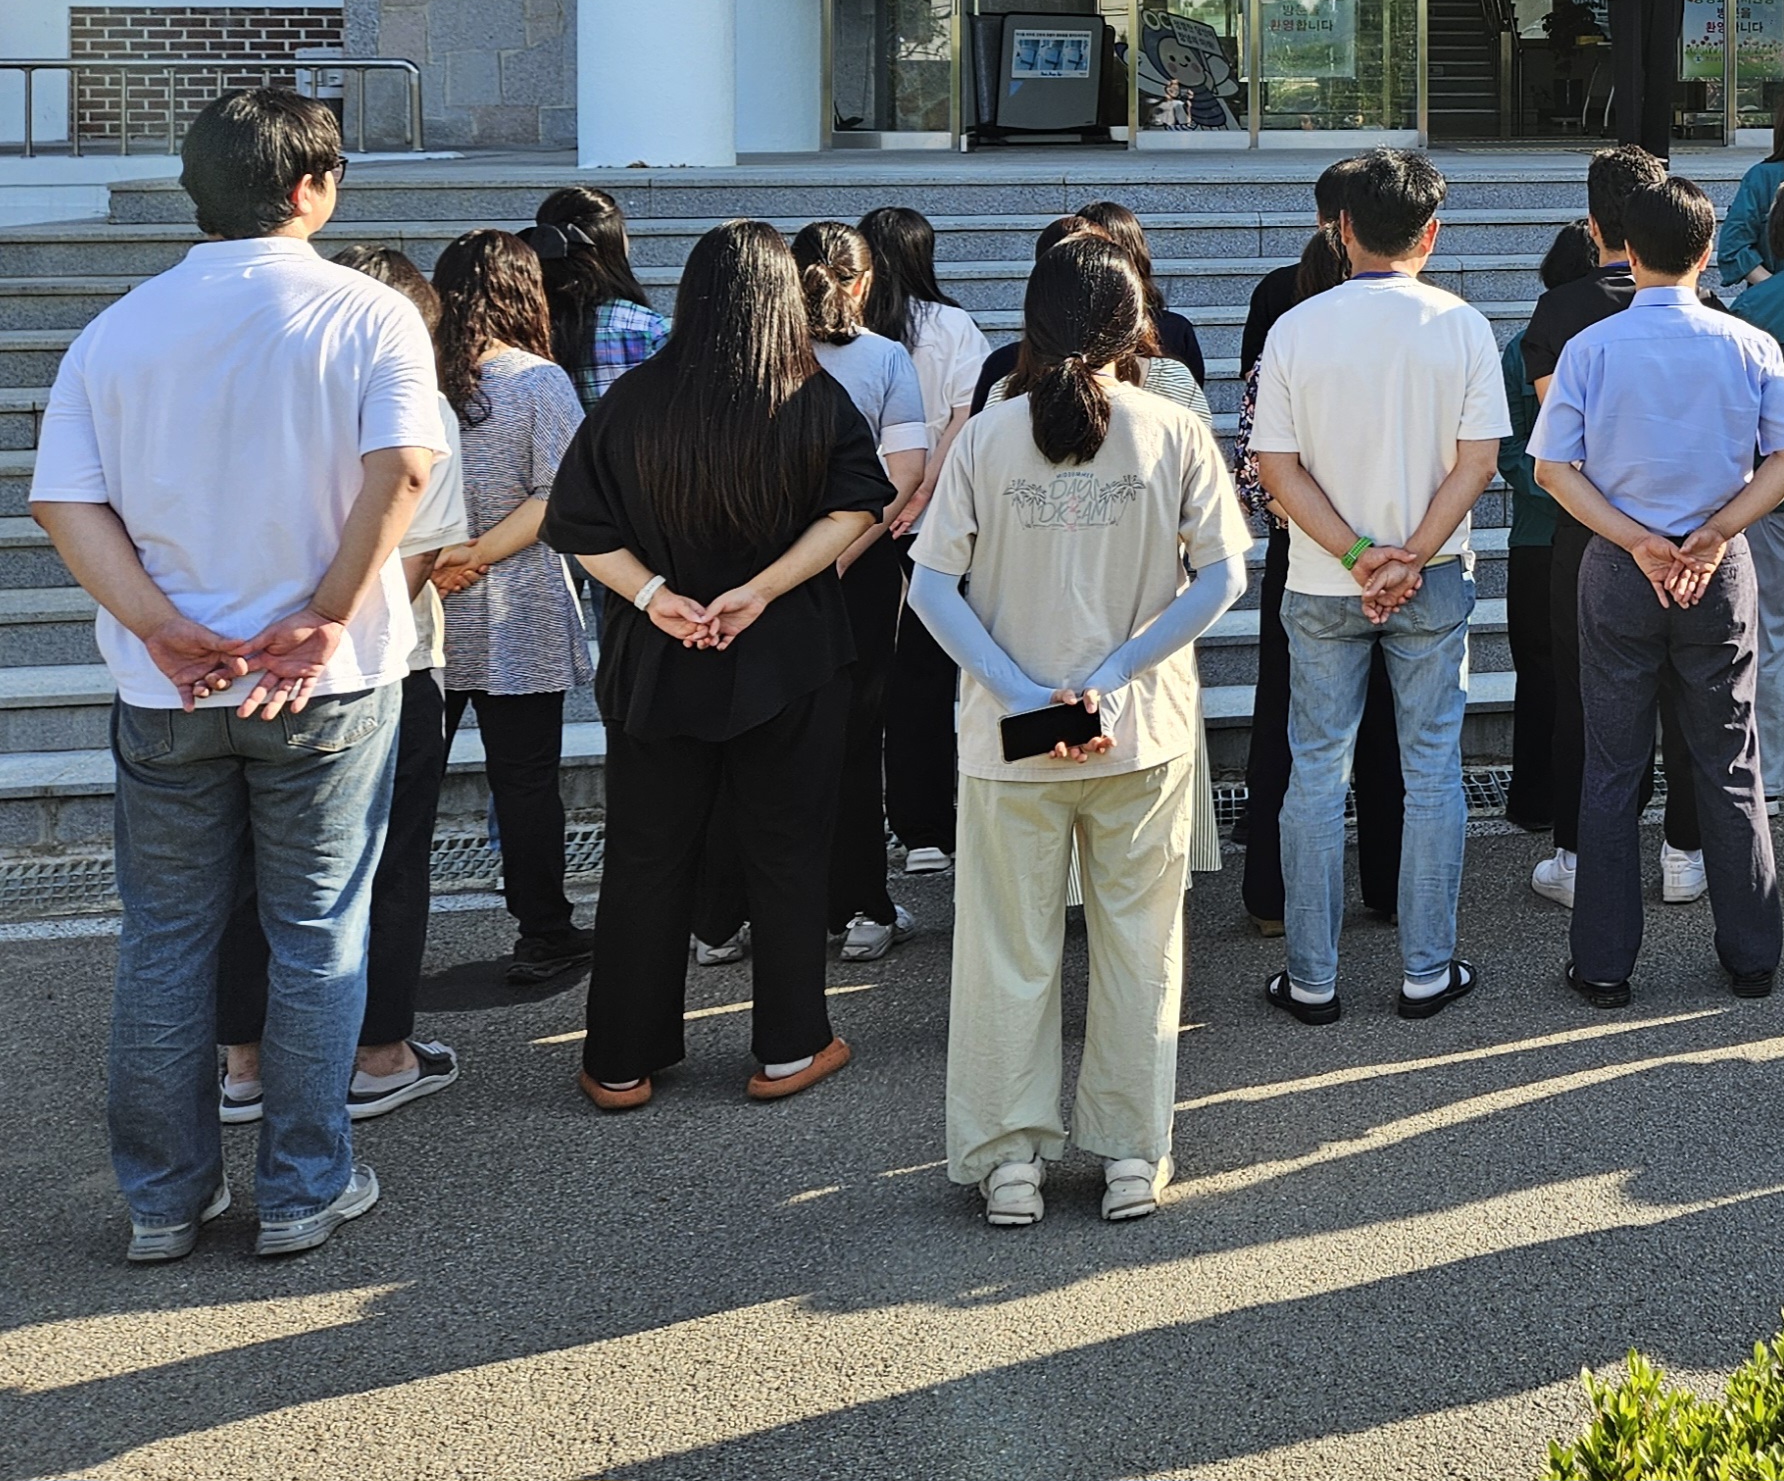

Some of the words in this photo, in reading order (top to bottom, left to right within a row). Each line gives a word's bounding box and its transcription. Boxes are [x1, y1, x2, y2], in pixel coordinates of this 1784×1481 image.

[1716, 6, 1752, 18] 방을
[1270, 18, 1334, 32] 환영합니다
[1705, 21, 1764, 33] 환영니다
[1056, 471, 1094, 479] MIDSUMMER
